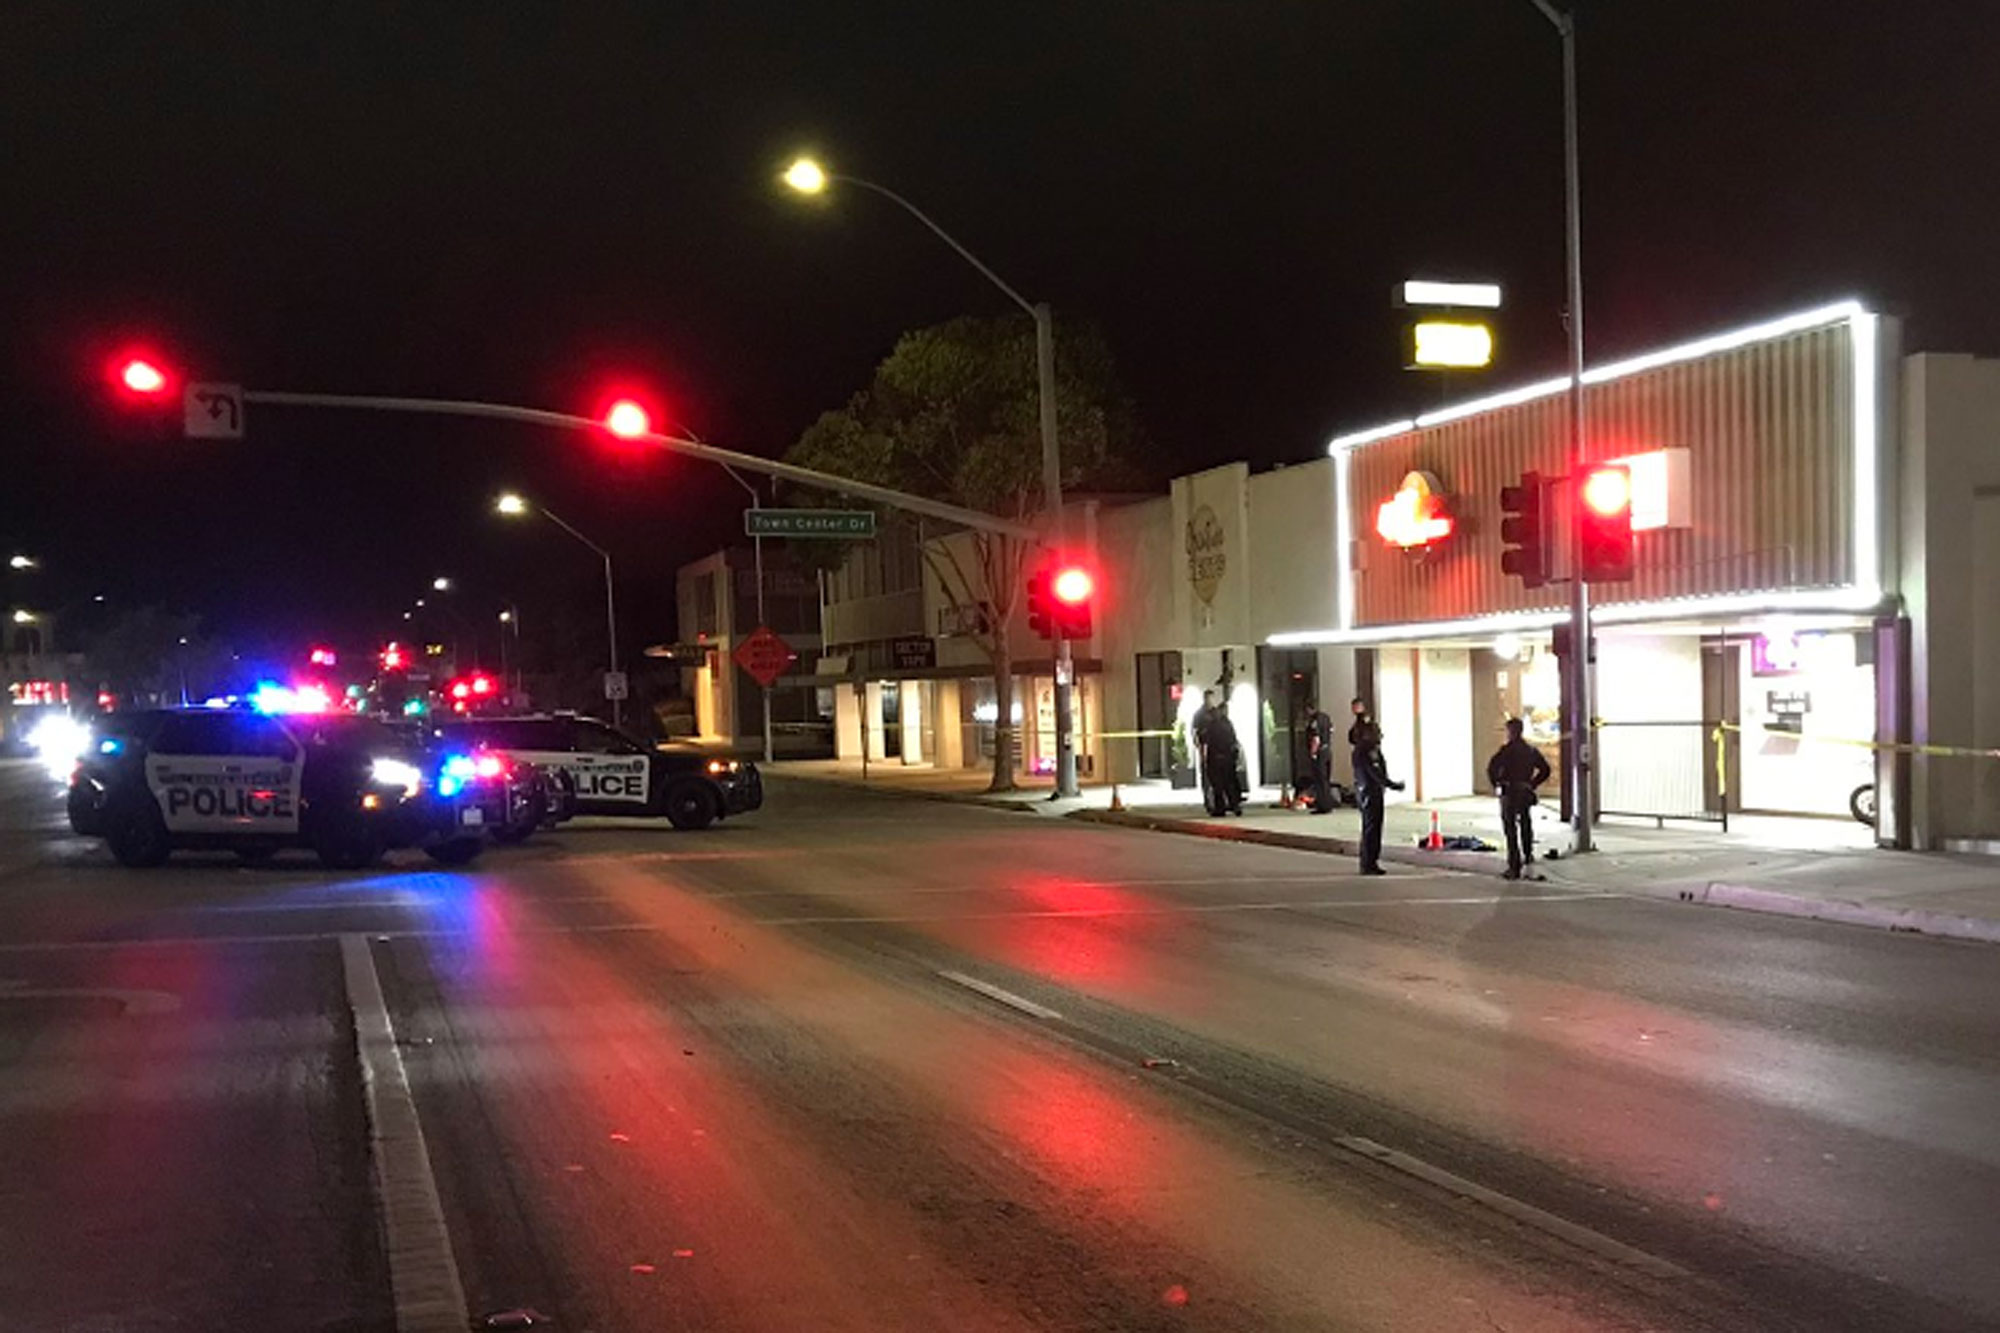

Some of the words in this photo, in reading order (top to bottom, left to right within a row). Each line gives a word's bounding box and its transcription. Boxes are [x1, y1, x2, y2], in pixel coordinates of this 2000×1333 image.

[754, 517, 790, 529] Town
[795, 518, 843, 530] Center
[849, 519, 866, 530] Dr
[574, 773, 643, 796] LICE
[167, 786, 294, 818] POLICE
